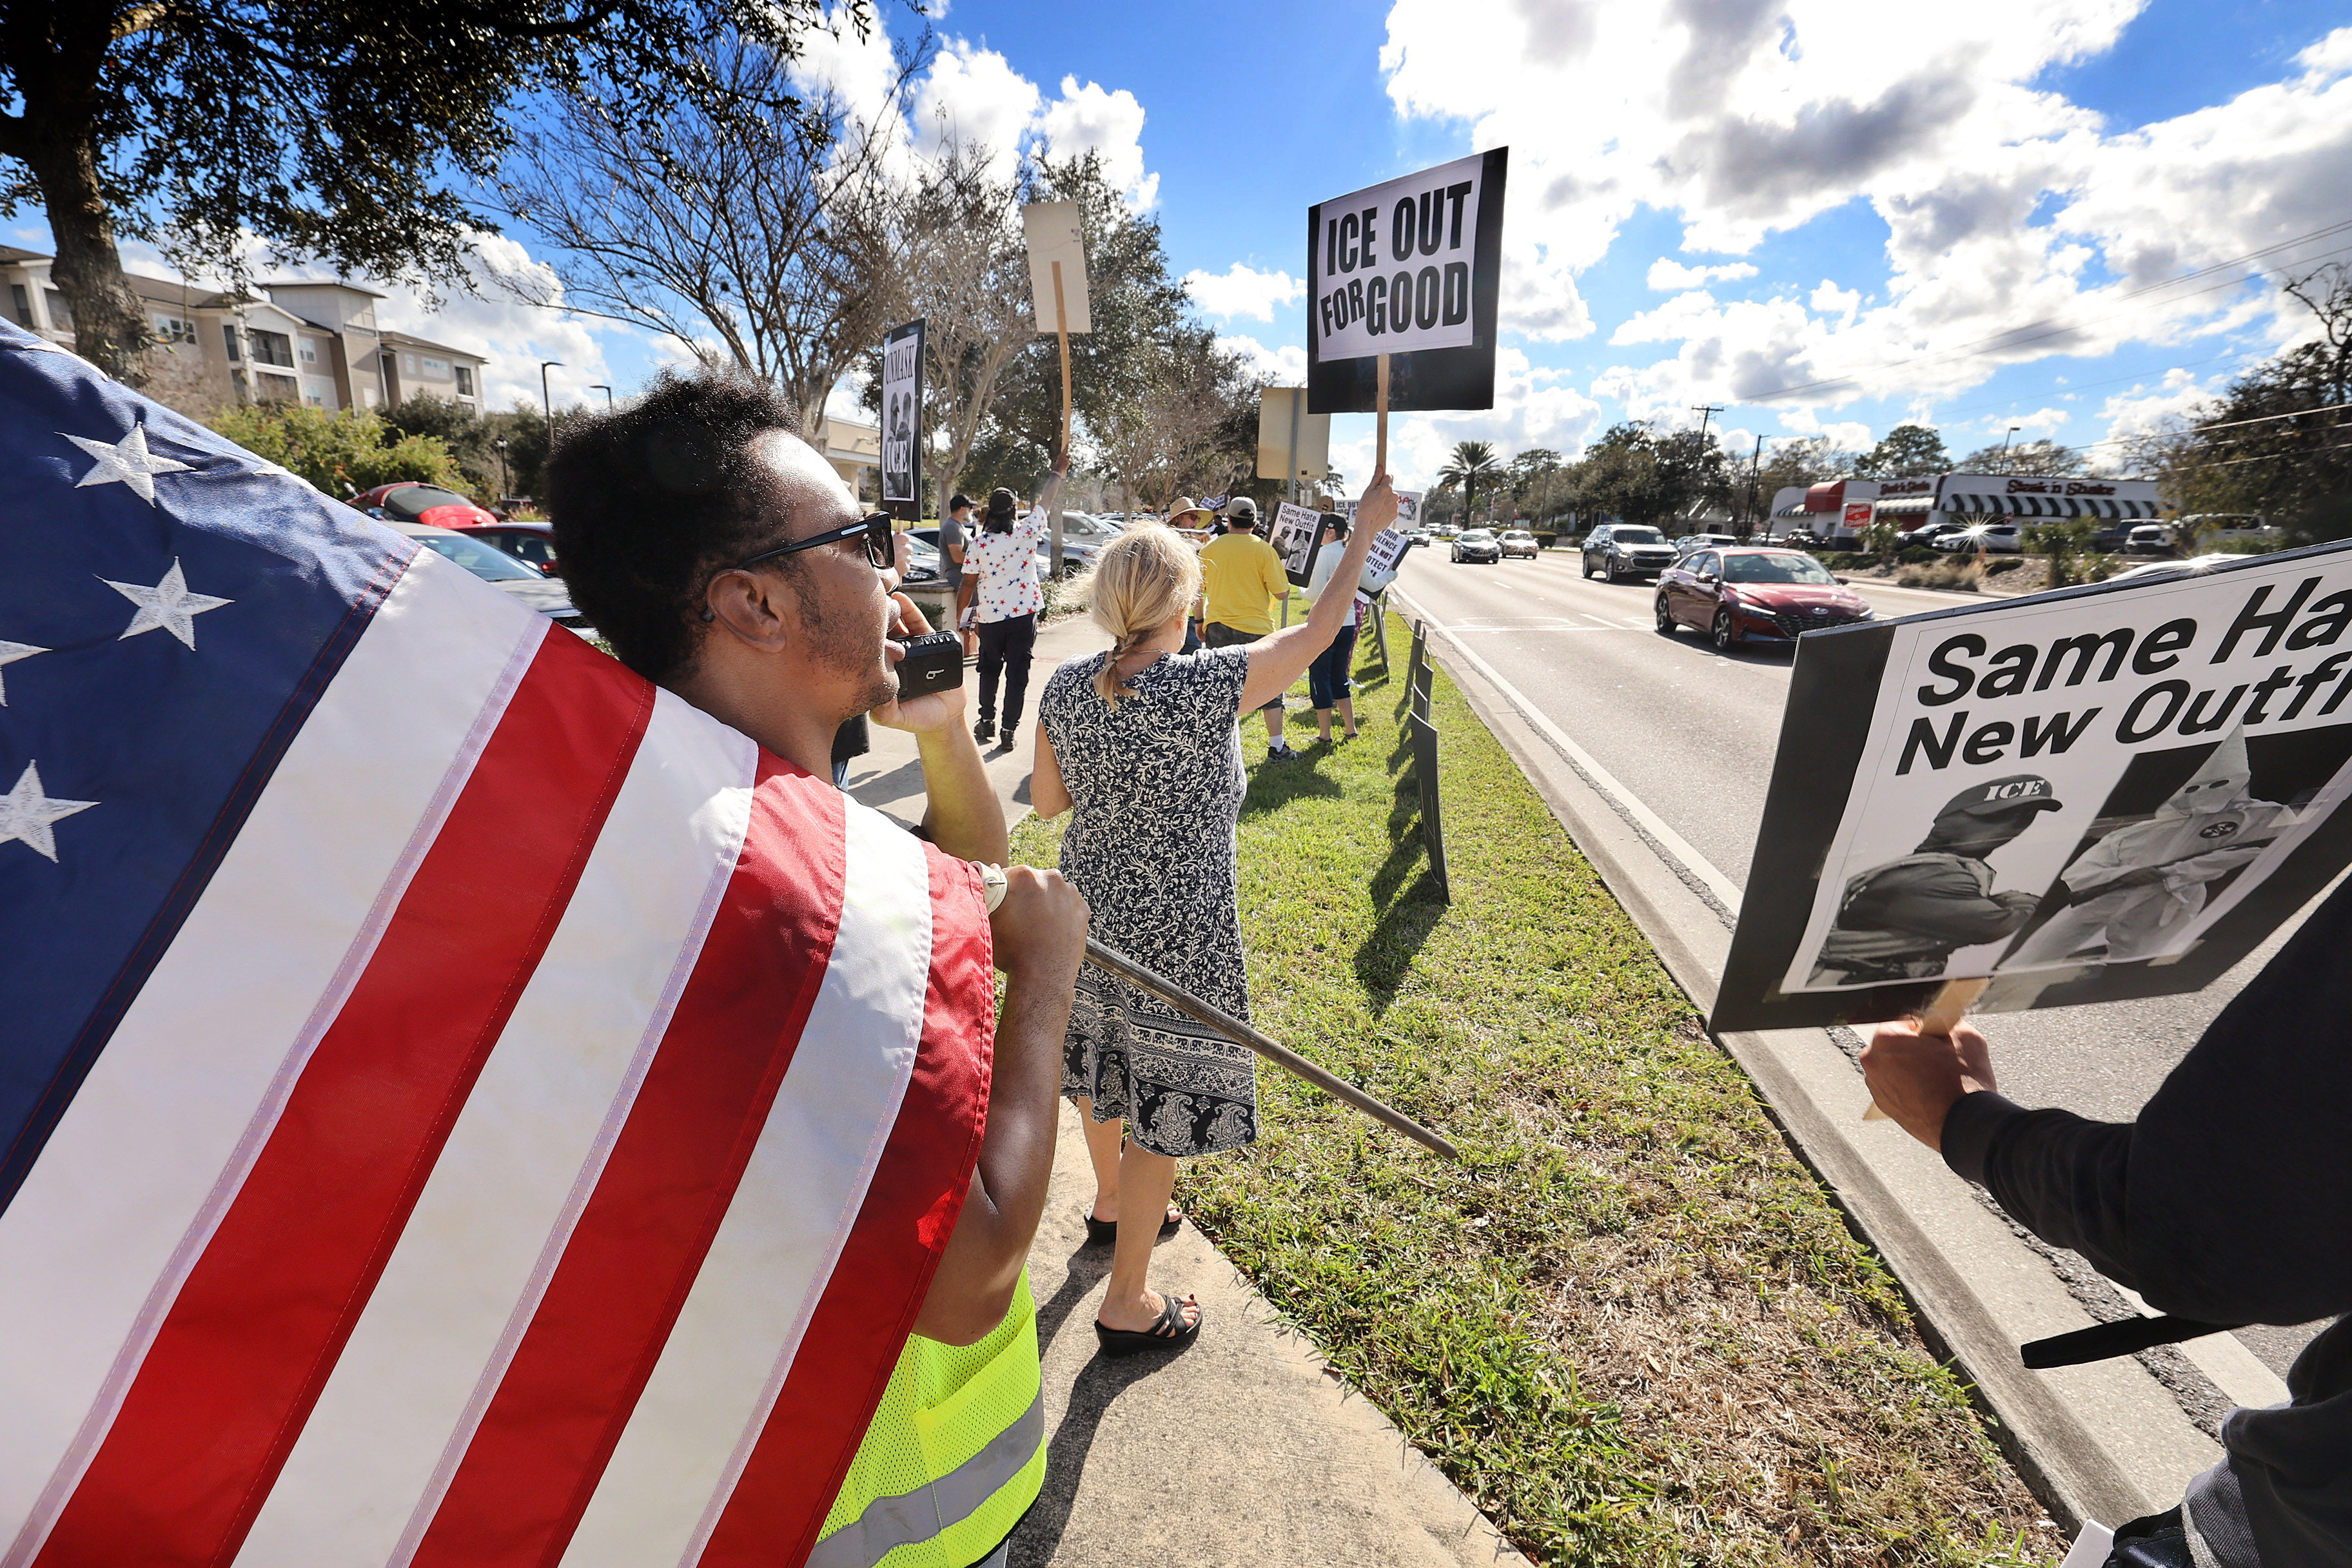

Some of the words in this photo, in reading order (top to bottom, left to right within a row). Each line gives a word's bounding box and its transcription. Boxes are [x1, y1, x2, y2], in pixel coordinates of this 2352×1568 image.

[1327, 206, 1378, 276] ICE
[1392, 180, 1473, 262] OUT
[1320, 278, 1366, 338] FOR
[1366, 261, 1469, 336] GOOD
[886, 344, 914, 385] UNMASK
[887, 440, 908, 473] ICE
[1279, 514, 1295, 525] New
[1295, 518, 1315, 531] Outfit
[1282, 505, 1300, 518] Same
[1300, 511, 1317, 522] Hate
[1370, 544, 1380, 554] ILL
[1378, 549, 1393, 561] NOT
[1376, 534, 1398, 551] ILENCE
[1366, 555, 1387, 572] OTECT
[1917, 617, 2197, 707] Same
[2209, 575, 2352, 665] Ha
[1895, 707, 2103, 776] New
[1983, 779, 2046, 801] ICE
